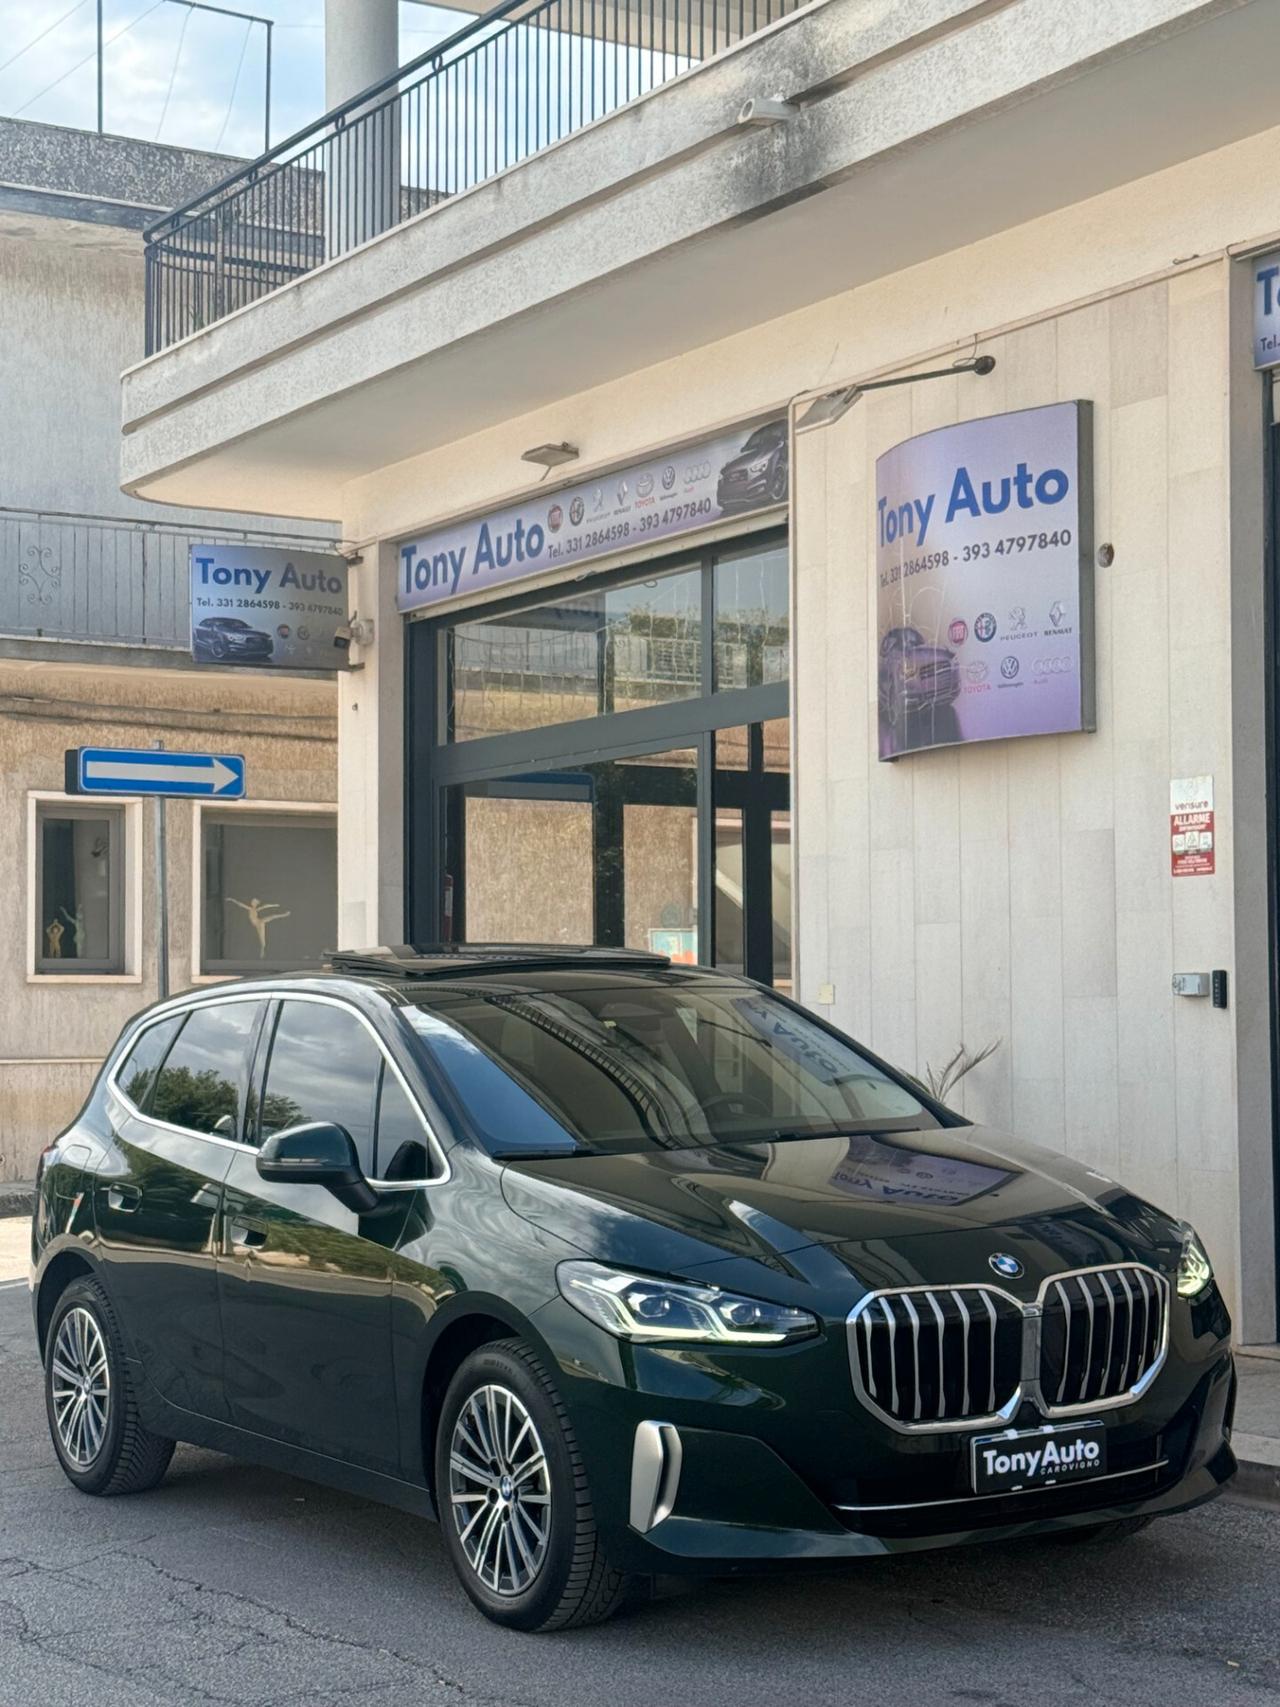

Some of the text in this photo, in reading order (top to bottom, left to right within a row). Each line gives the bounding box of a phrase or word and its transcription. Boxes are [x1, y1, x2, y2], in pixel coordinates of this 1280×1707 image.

[1256, 265, 1280, 315] T
[878, 462, 1069, 547] Tony Auto
[548, 543, 564, 559] Tel.
[566, 535, 583, 554] 331
[585, 521, 630, 547] 2864598
[639, 512, 660, 533] 393
[662, 497, 712, 526] 4797840
[401, 544, 467, 595] Tony
[473, 519, 544, 575] Auto
[903, 550, 950, 578] 2864598
[962, 542, 991, 563] 393
[994, 528, 1072, 556] 4797840
[195, 556, 343, 595] Tony Auto
[197, 596, 214, 607] Tel.
[216, 598, 234, 608] 331
[236, 599, 281, 610] 2864598
[1000, 631, 1038, 641] PEUGEOT
[1174, 800, 1209, 811] verisure
[983, 1438, 1100, 1477] TonyAuto
[1040, 1459, 1100, 1475] CAROVIGNO
